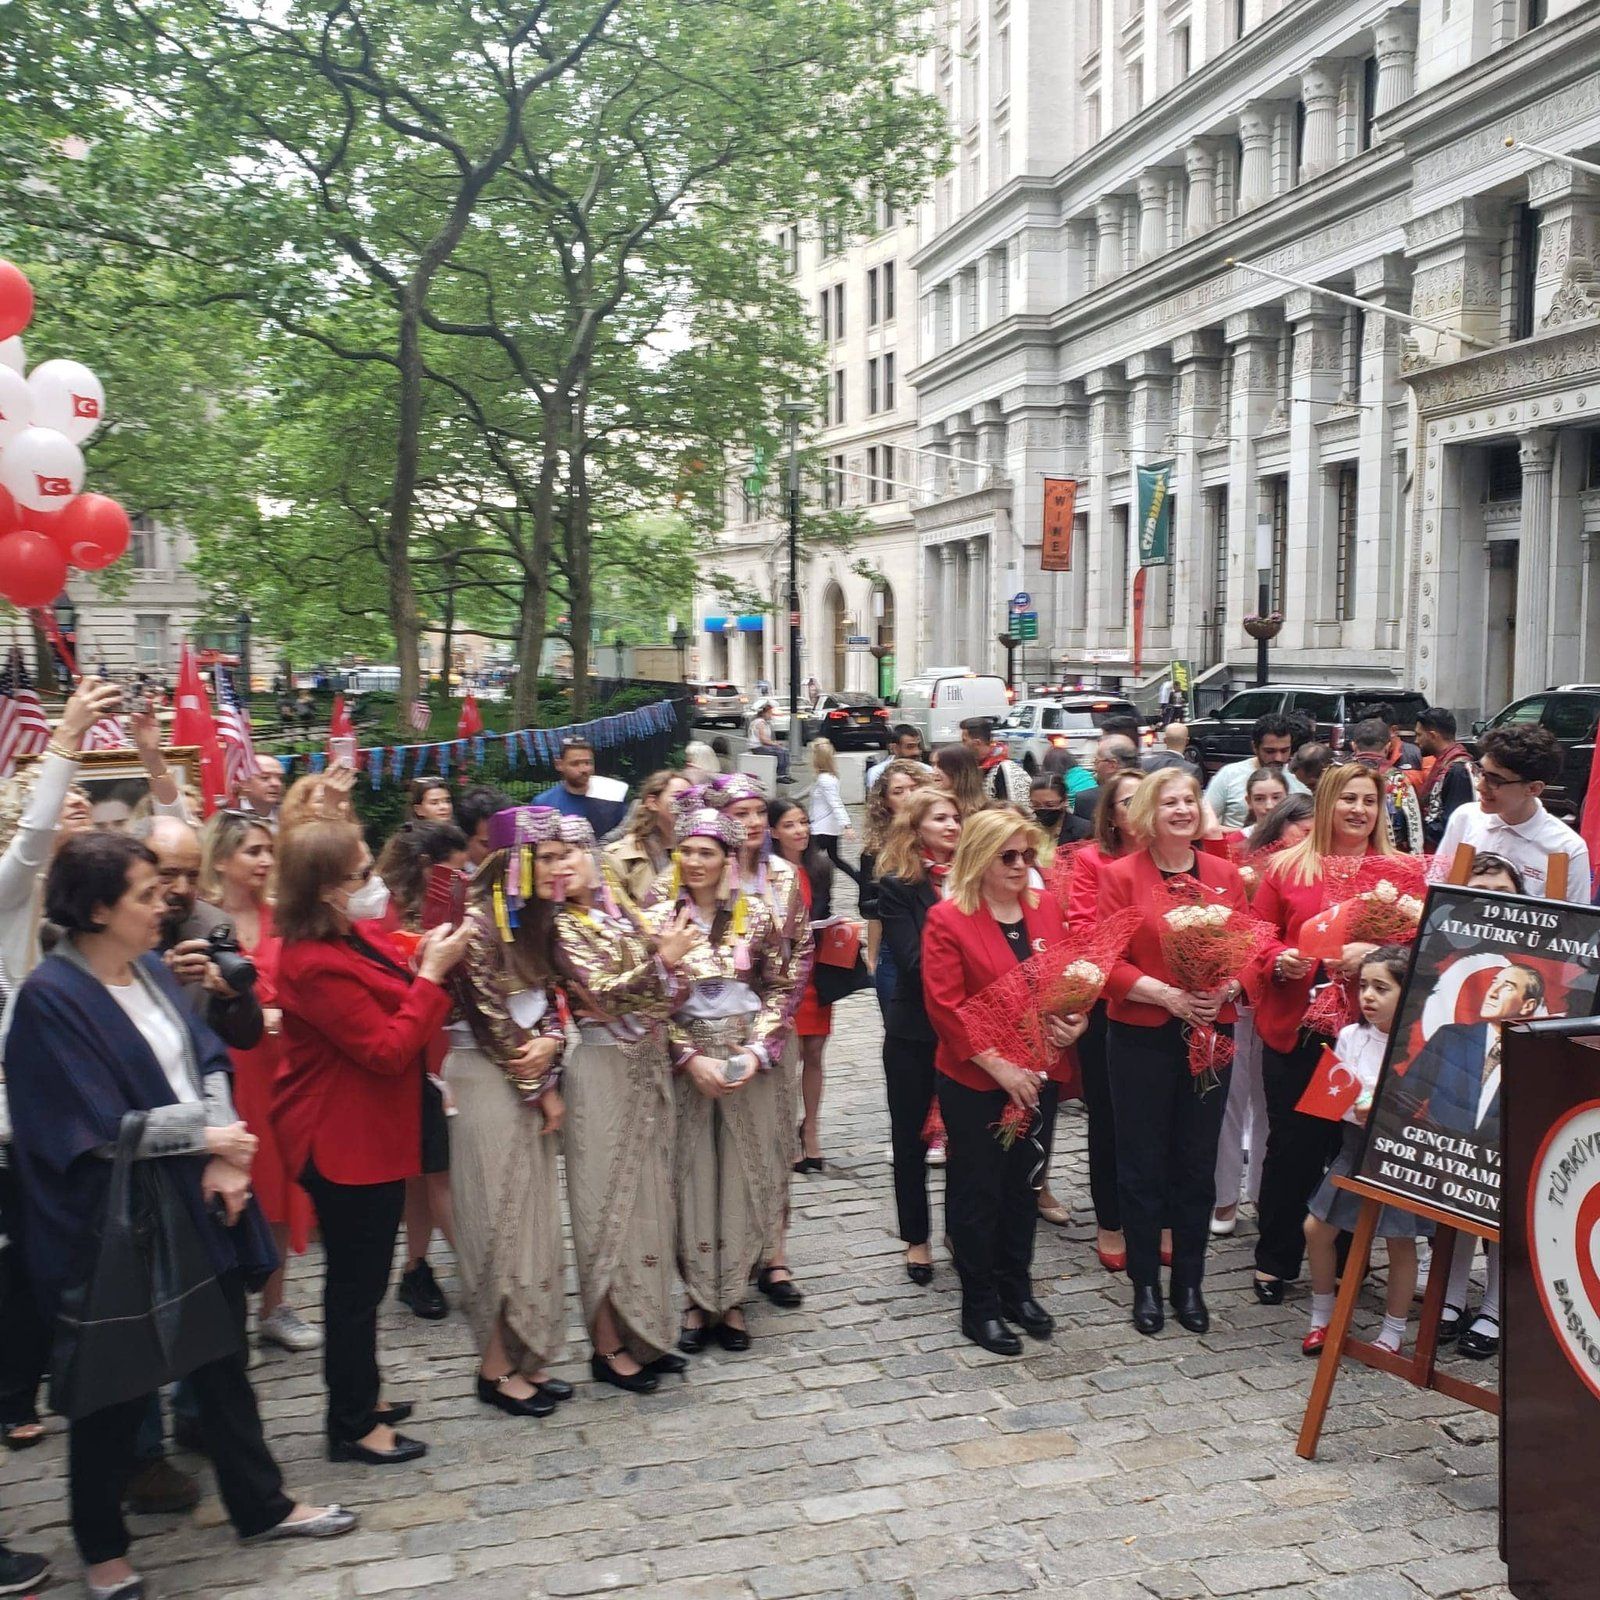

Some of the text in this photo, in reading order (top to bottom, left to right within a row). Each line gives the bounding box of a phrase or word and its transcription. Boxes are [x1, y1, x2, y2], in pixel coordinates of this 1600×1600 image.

[1198, 274, 1232, 304] GREEN
[1051, 495, 1066, 552] WINE
[1482, 905, 1559, 929] 19 MAYIS
[1527, 931, 1541, 948] Ü
[1545, 937, 1600, 959] ANMA
[1374, 1137, 1418, 1162] SPOR
[1402, 1126, 1479, 1159] GENÇLİK
[1379, 1161, 1438, 1190] KUTLU
